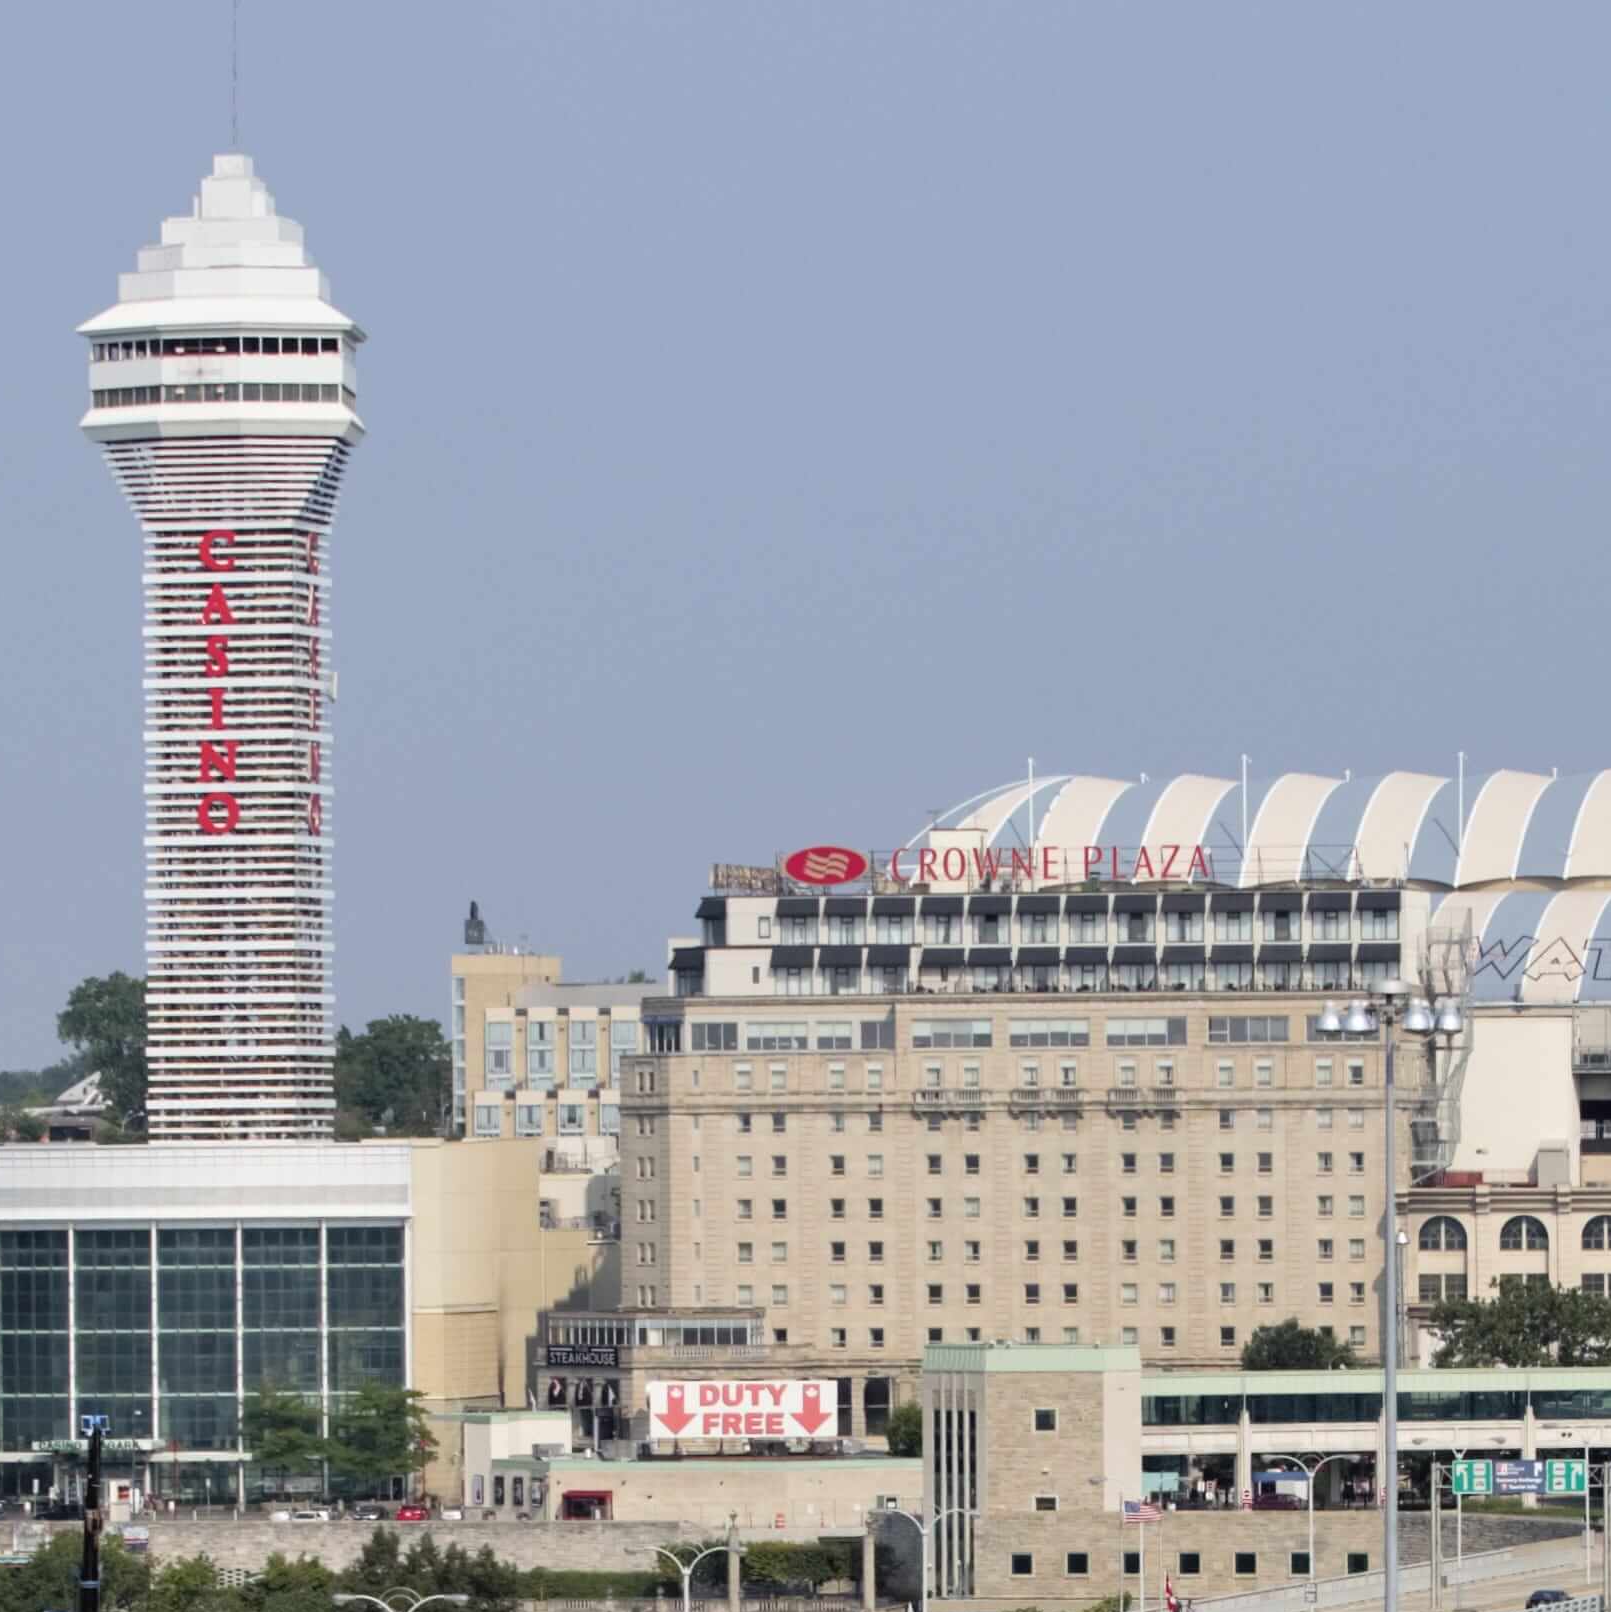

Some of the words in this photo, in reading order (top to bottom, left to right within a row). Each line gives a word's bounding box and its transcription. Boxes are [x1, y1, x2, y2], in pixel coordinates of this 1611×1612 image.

[198, 530, 240, 834] CASINO
[891, 847, 1059, 881] CROWNE
[1083, 844, 1210, 879] PLAZA
[549, 1351, 616, 1365] STEAKHOUSE
[699, 1383, 787, 1407] DUTY
[702, 1412, 785, 1435] FREE
